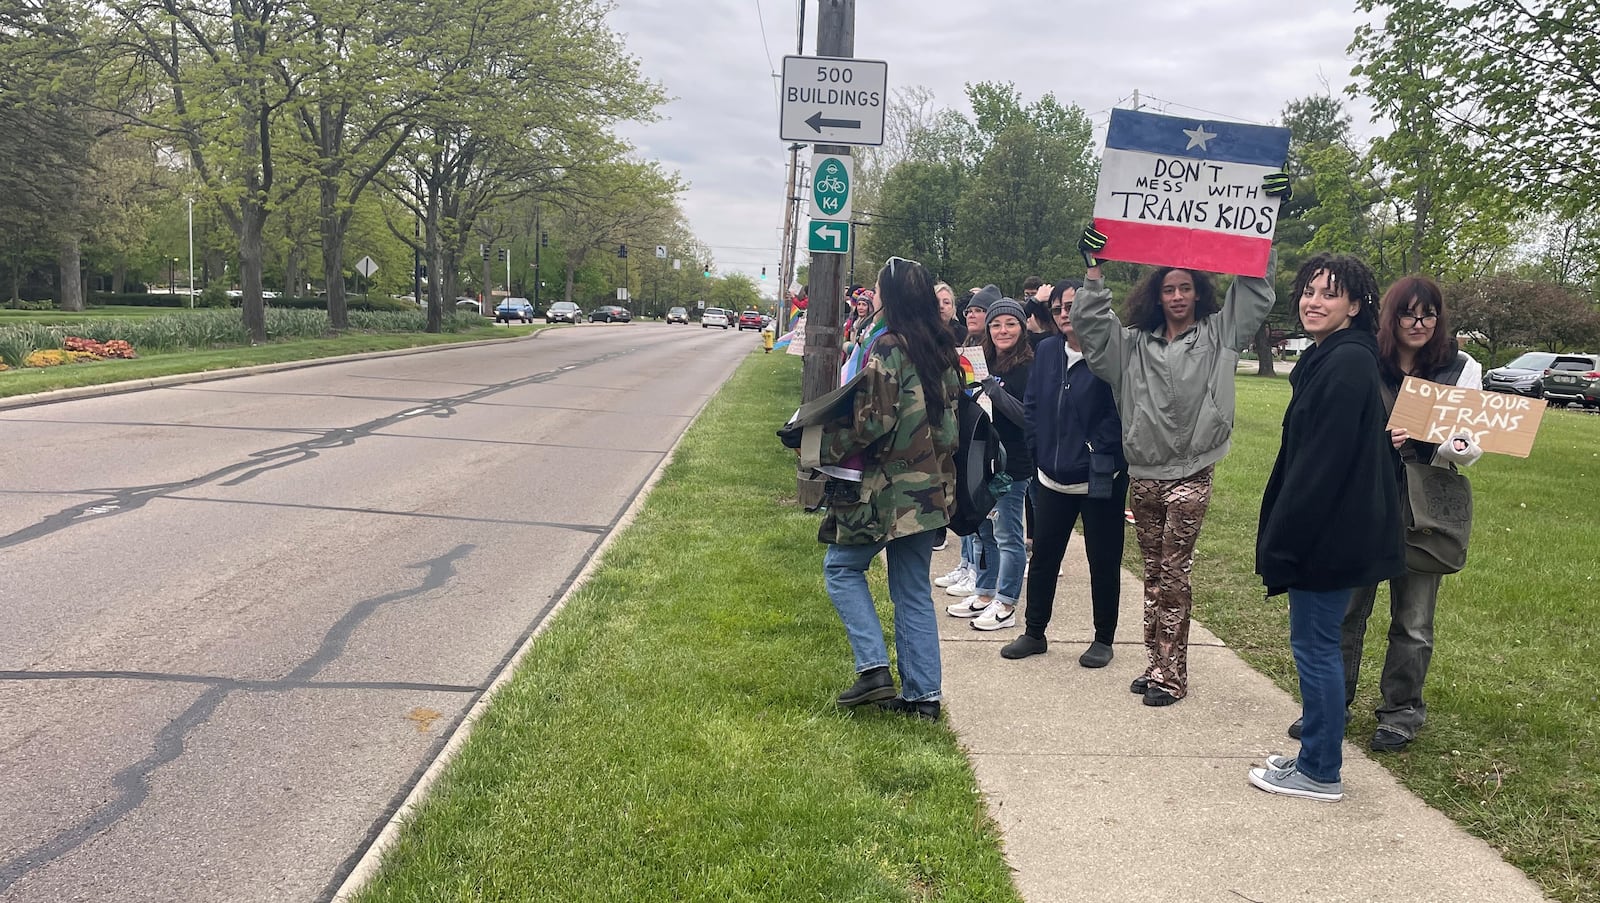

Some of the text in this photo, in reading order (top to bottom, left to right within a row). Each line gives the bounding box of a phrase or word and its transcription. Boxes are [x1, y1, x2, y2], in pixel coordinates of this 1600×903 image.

[817, 66, 853, 83] 500
[787, 87, 880, 107] BUILDINGS
[1154, 158, 1223, 183] DON'T
[1136, 177, 1258, 199] MESS WITH
[822, 196, 839, 210] K4
[1111, 191, 1274, 234] TRANS KIDS
[1405, 379, 1530, 411] LOVE YOUR
[1433, 405, 1524, 432] TRANS
